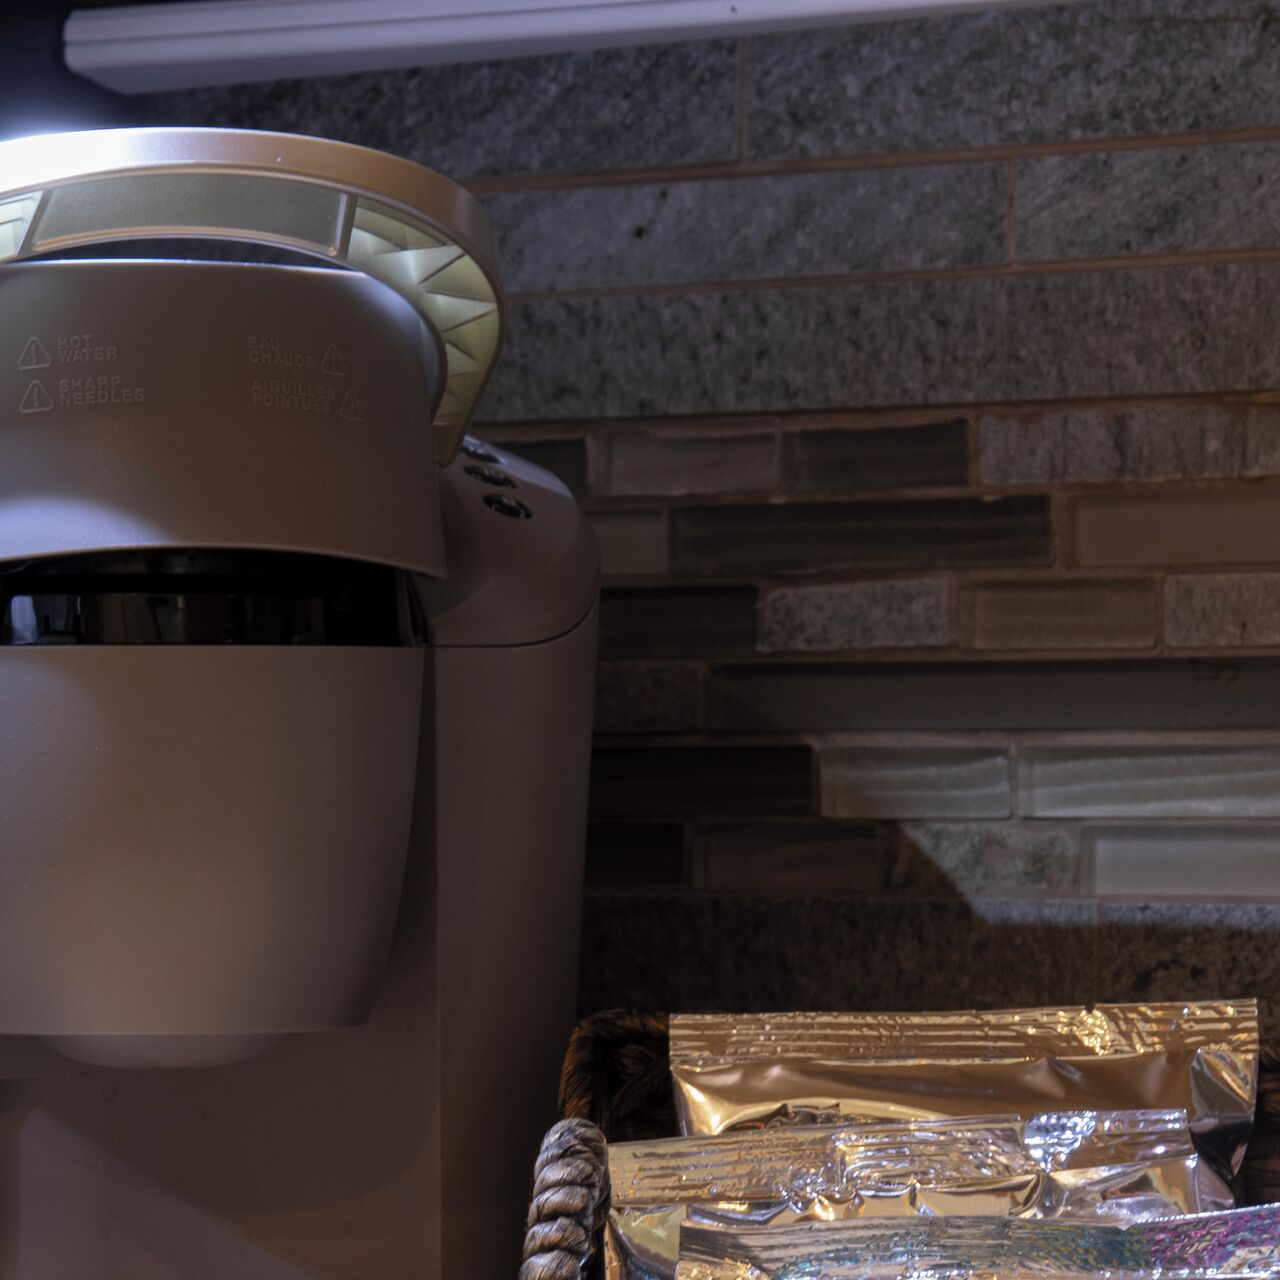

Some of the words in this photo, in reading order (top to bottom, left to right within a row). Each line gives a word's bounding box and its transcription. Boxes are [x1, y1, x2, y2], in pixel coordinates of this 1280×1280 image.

[57, 335, 94, 351] HOT
[59, 346, 118, 363] WATER
[60, 376, 121, 393] SHARP
[60, 388, 145, 407] NEEDLES
